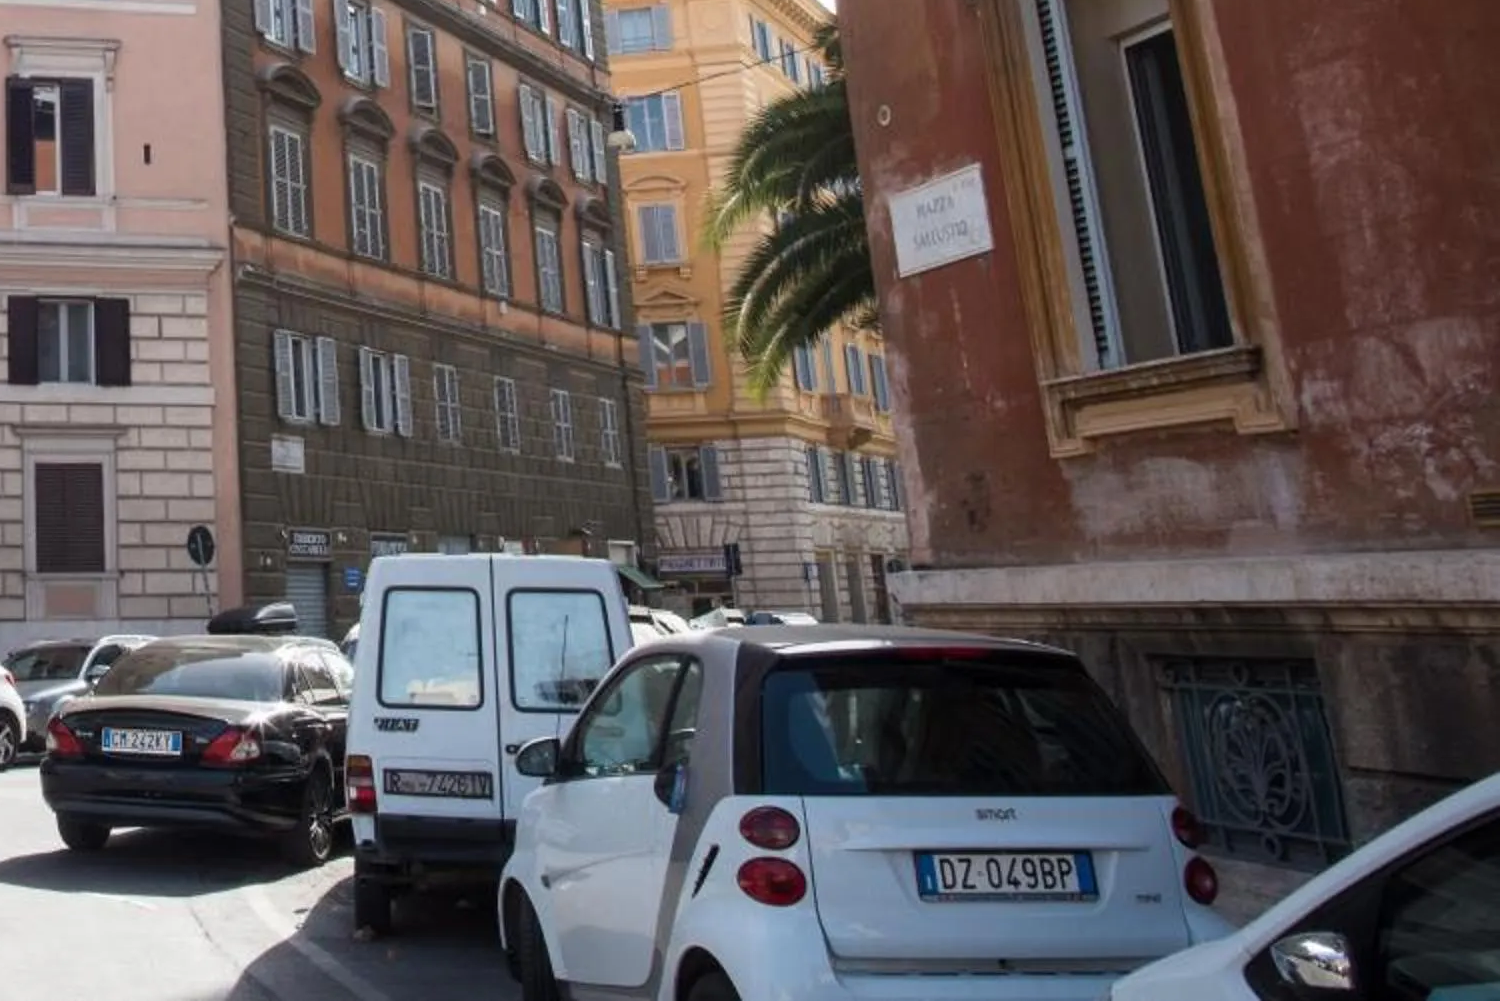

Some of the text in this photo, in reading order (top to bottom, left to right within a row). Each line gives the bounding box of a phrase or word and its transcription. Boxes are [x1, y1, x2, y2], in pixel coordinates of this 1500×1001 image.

[916, 195, 955, 218] PIAZZA
[974, 807, 1018, 823] smart
[939, 857, 977, 890] DZ
[986, 857, 1074, 890] 049BP
